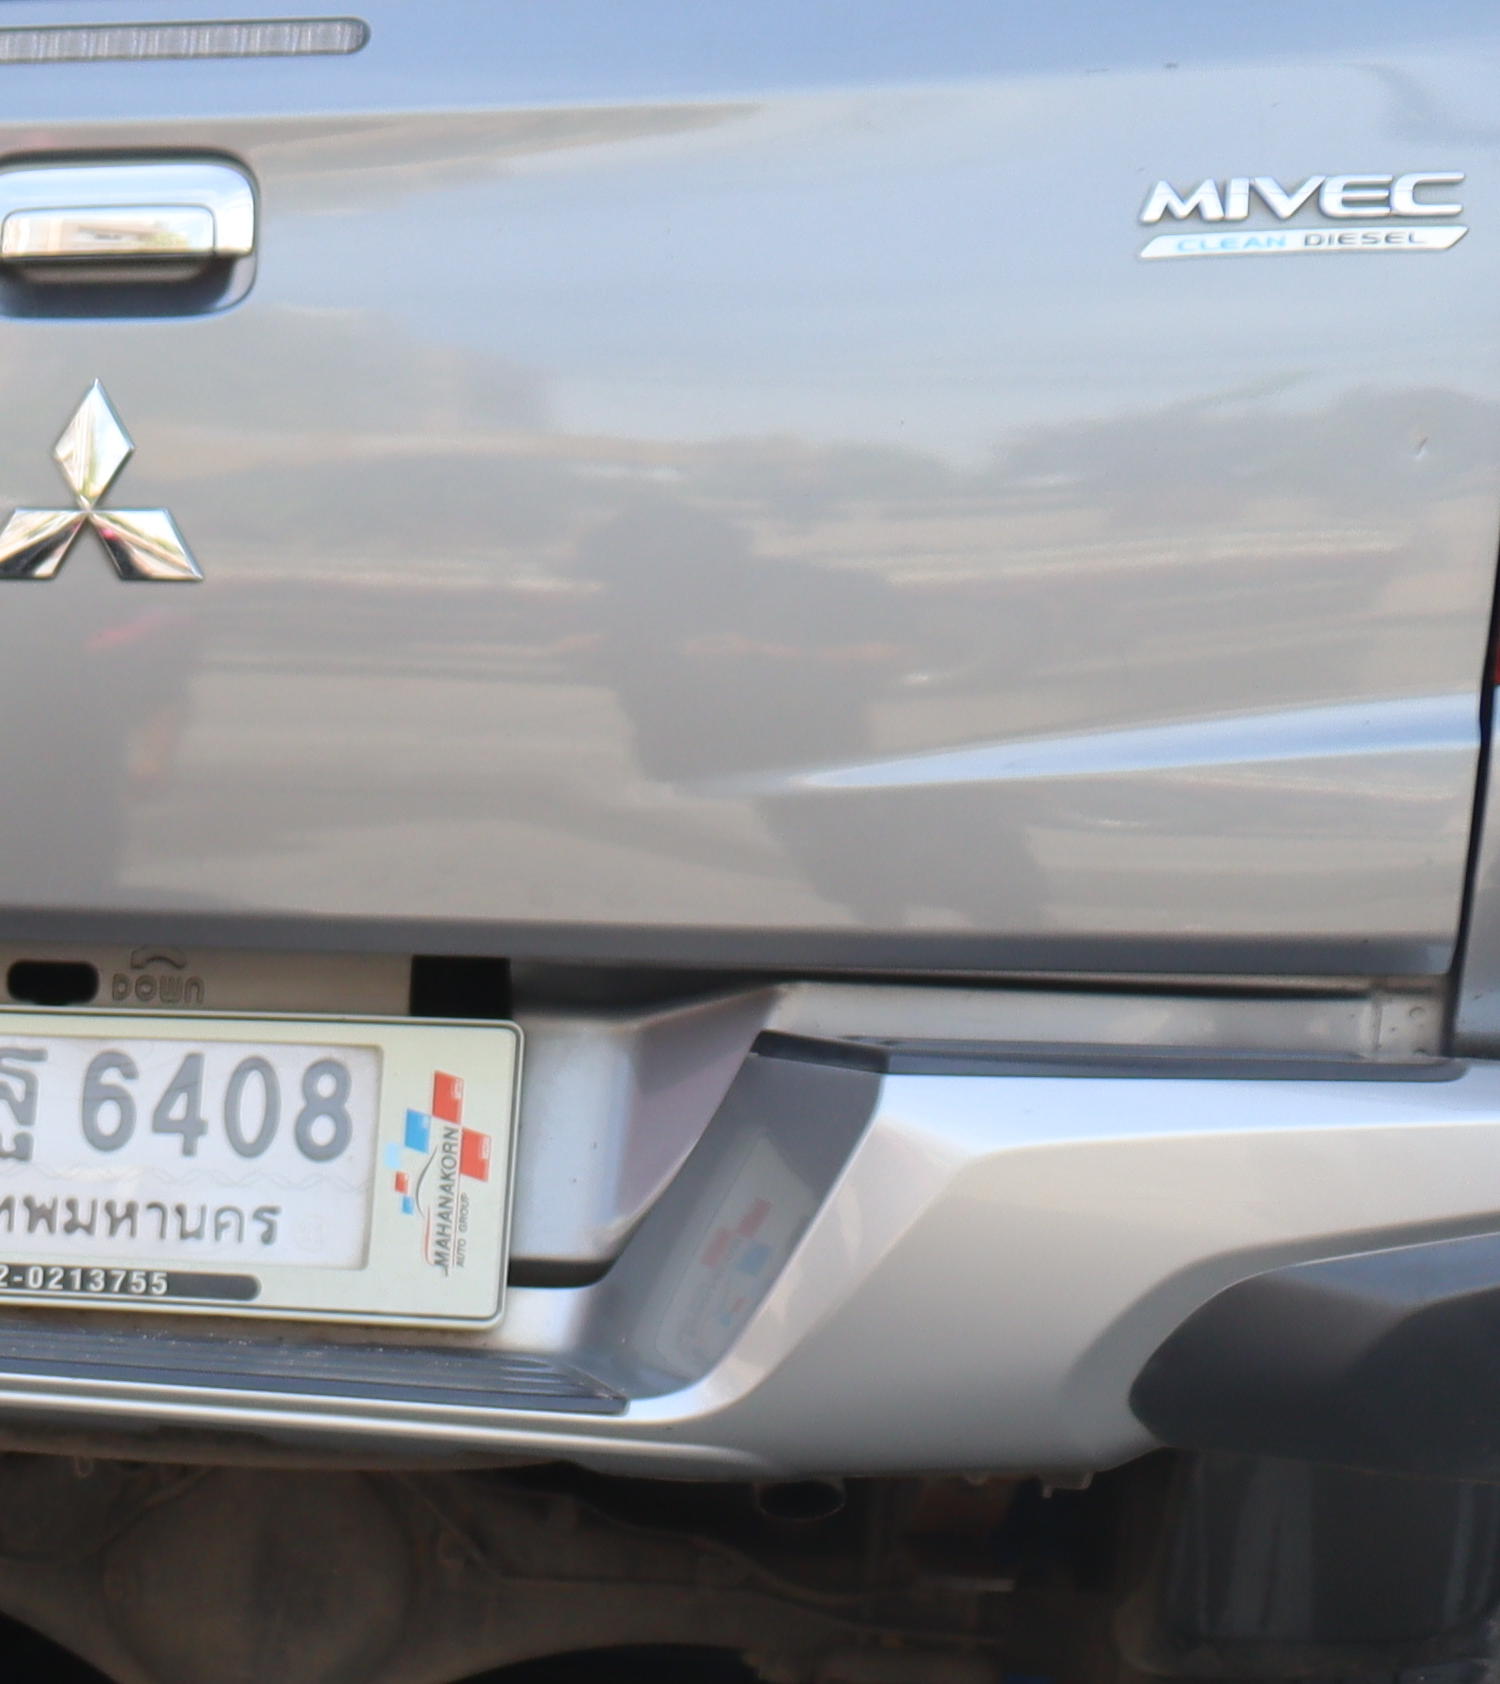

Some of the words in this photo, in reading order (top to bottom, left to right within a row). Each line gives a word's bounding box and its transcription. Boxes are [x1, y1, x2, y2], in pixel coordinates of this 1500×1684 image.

[1140, 171, 1465, 224] MIVEC
[1176, 235, 1288, 252] CLEAN
[1304, 231, 1428, 248] DIESEL
[80, 1050, 353, 1162] 6408
[433, 1126, 460, 1270] MAHANAKORN
[458, 1192, 470, 1233] GROUP
[456, 1239, 467, 1268] AUTO
